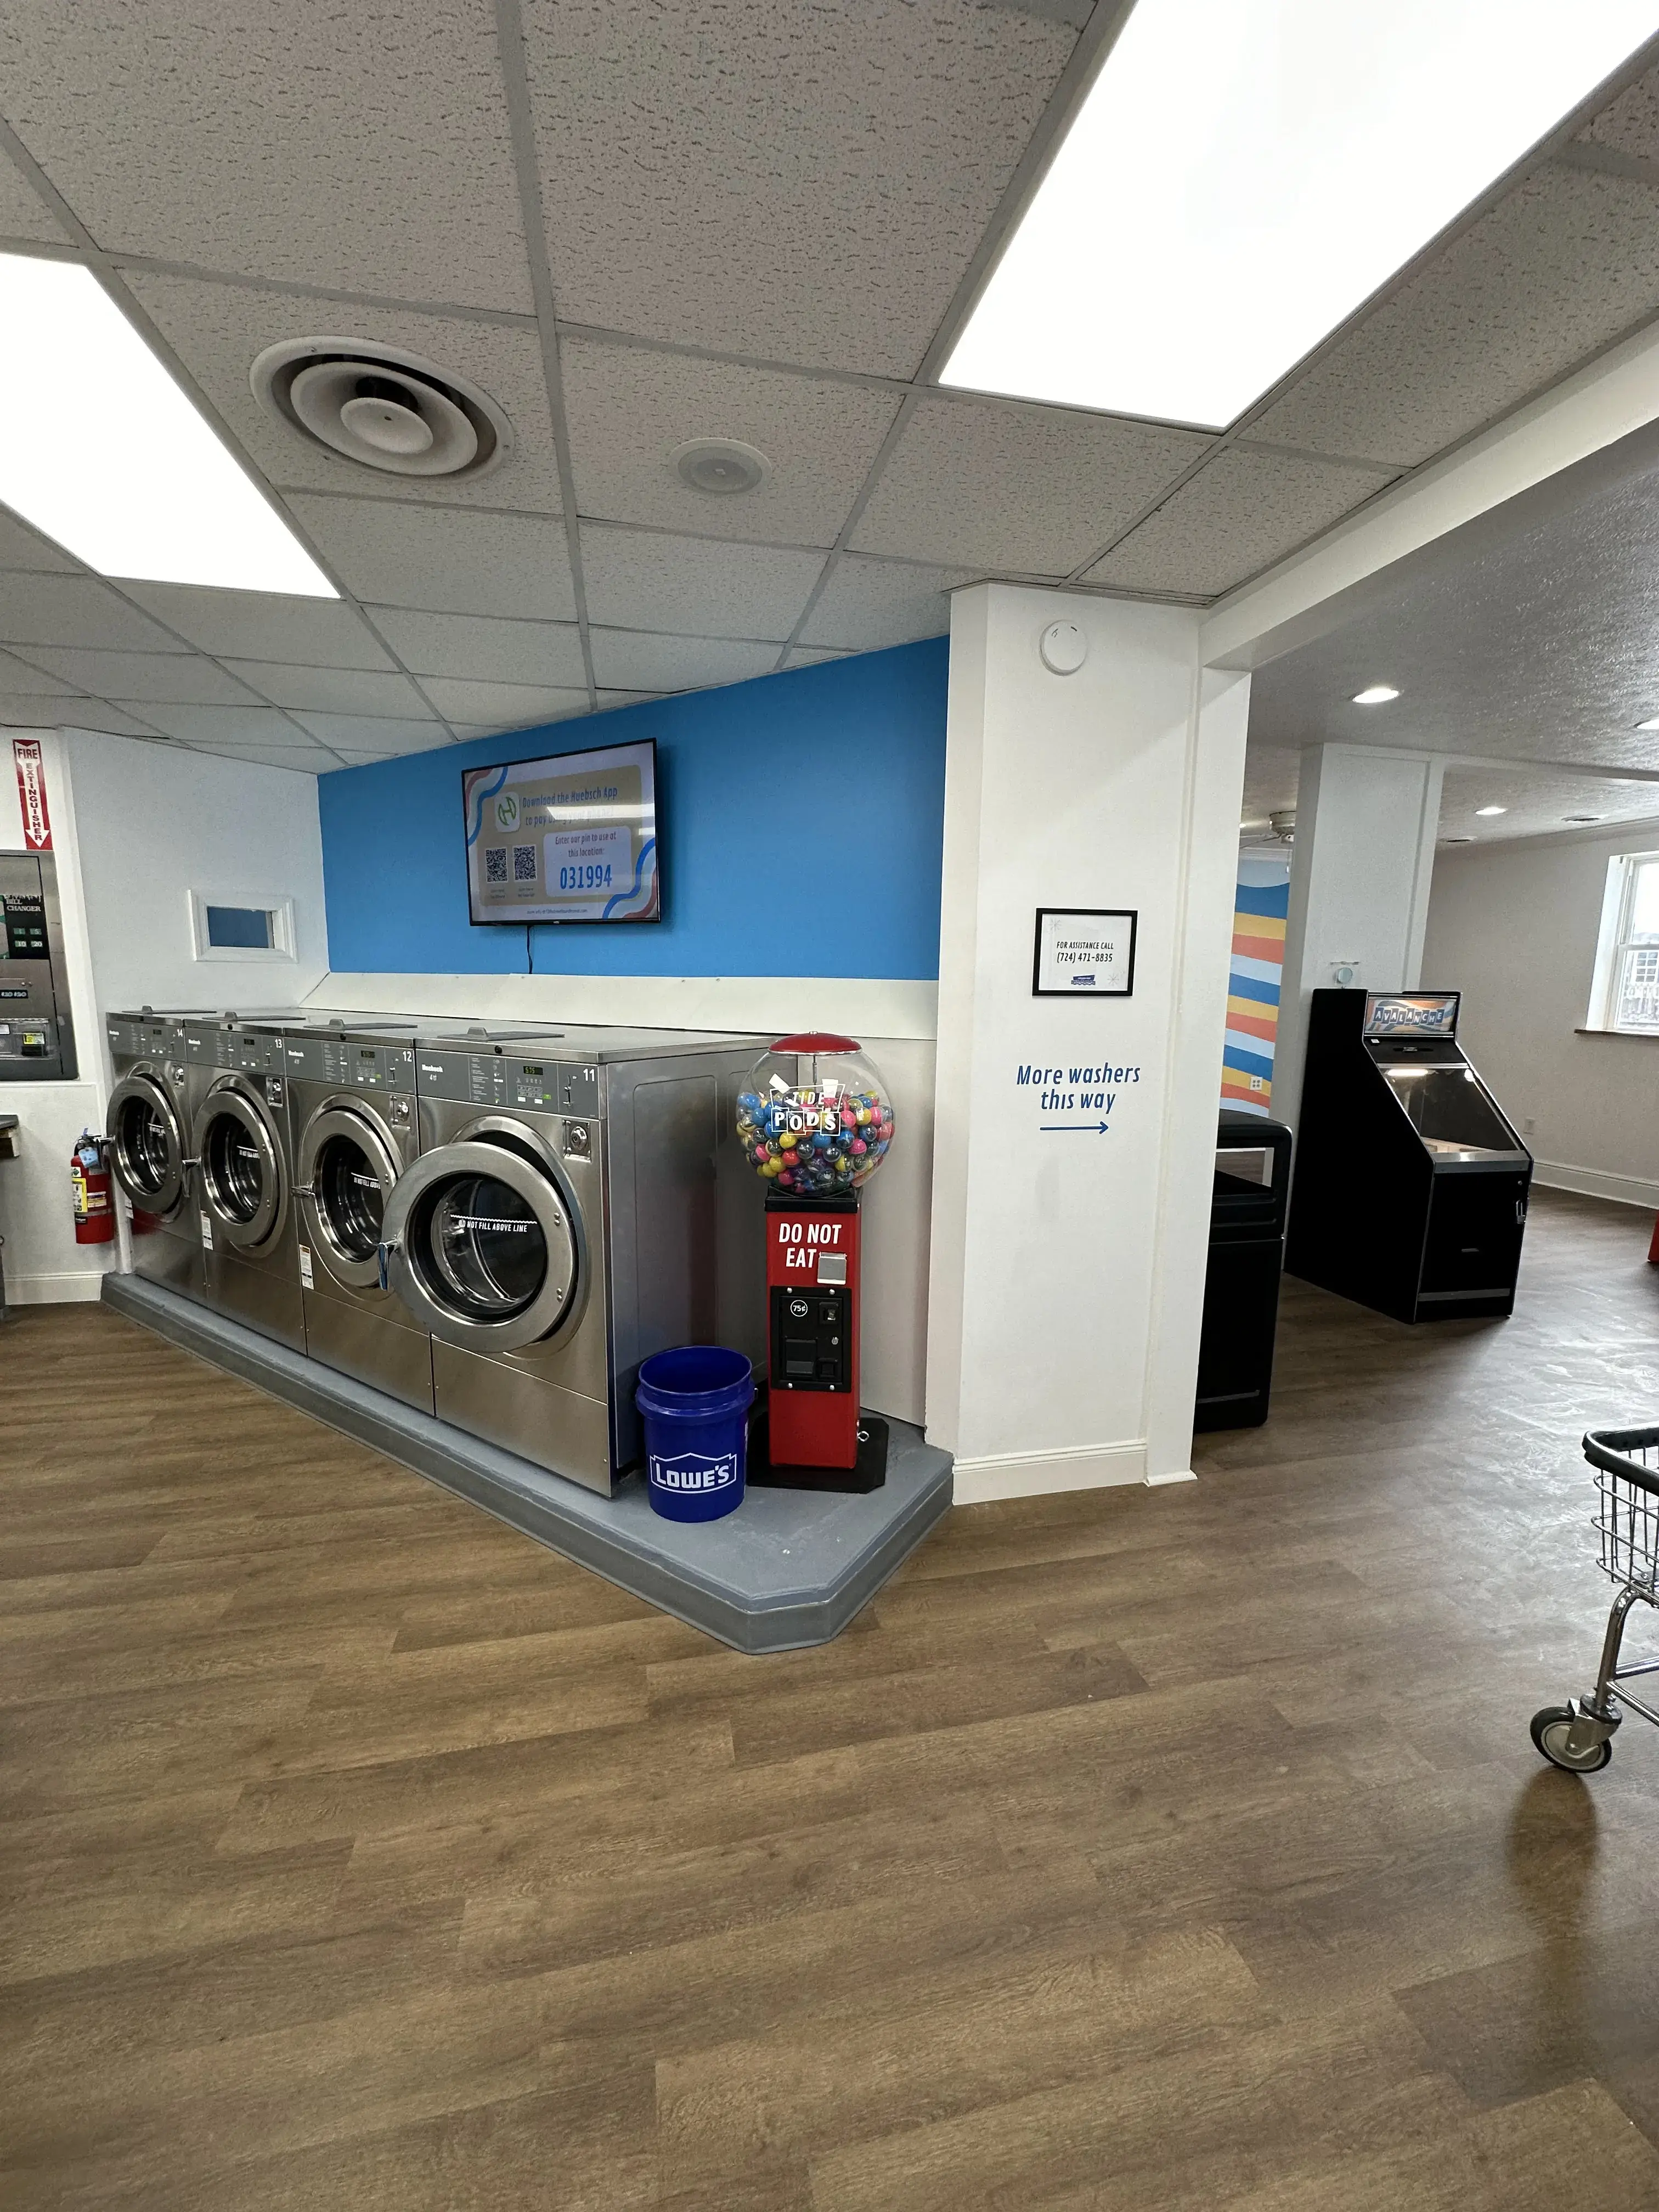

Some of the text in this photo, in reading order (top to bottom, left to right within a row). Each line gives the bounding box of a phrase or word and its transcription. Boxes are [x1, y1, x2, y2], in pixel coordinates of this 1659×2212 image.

[18, 748, 38, 759] FIRE
[26, 763, 42, 840] EXTINGUISHER
[523, 787, 618, 808] Download the Huebsch App
[526, 816, 532, 826] to
[534, 815, 547, 827] pay
[555, 837, 569, 845] Enter
[582, 834, 590, 845] pin
[610, 832, 616, 840] at
[568, 848, 578, 857] this
[560, 864, 612, 889] 031994
[1057, 952, 1113, 963] (724) 471-8835
[1375, 1011, 1442, 1023] AVALANCHE
[275, 1039, 283, 1048] 13
[402, 1051, 412, 1062] 12
[583, 1069, 595, 1082] 11
[1017, 1062, 1141, 1085] More washers
[792, 1092, 824, 1105] TIDE
[1041, 1088, 1116, 1114] this way
[775, 1111, 836, 1130] PODS
[467, 1221, 478, 1229] NOT
[479, 1222, 491, 1230] FILL
[492, 1223, 511, 1232] ABOVE
[779, 1223, 842, 1244] DO NOT
[786, 1248, 817, 1268] EAT
[656, 1463, 730, 1489] LOWE'S
